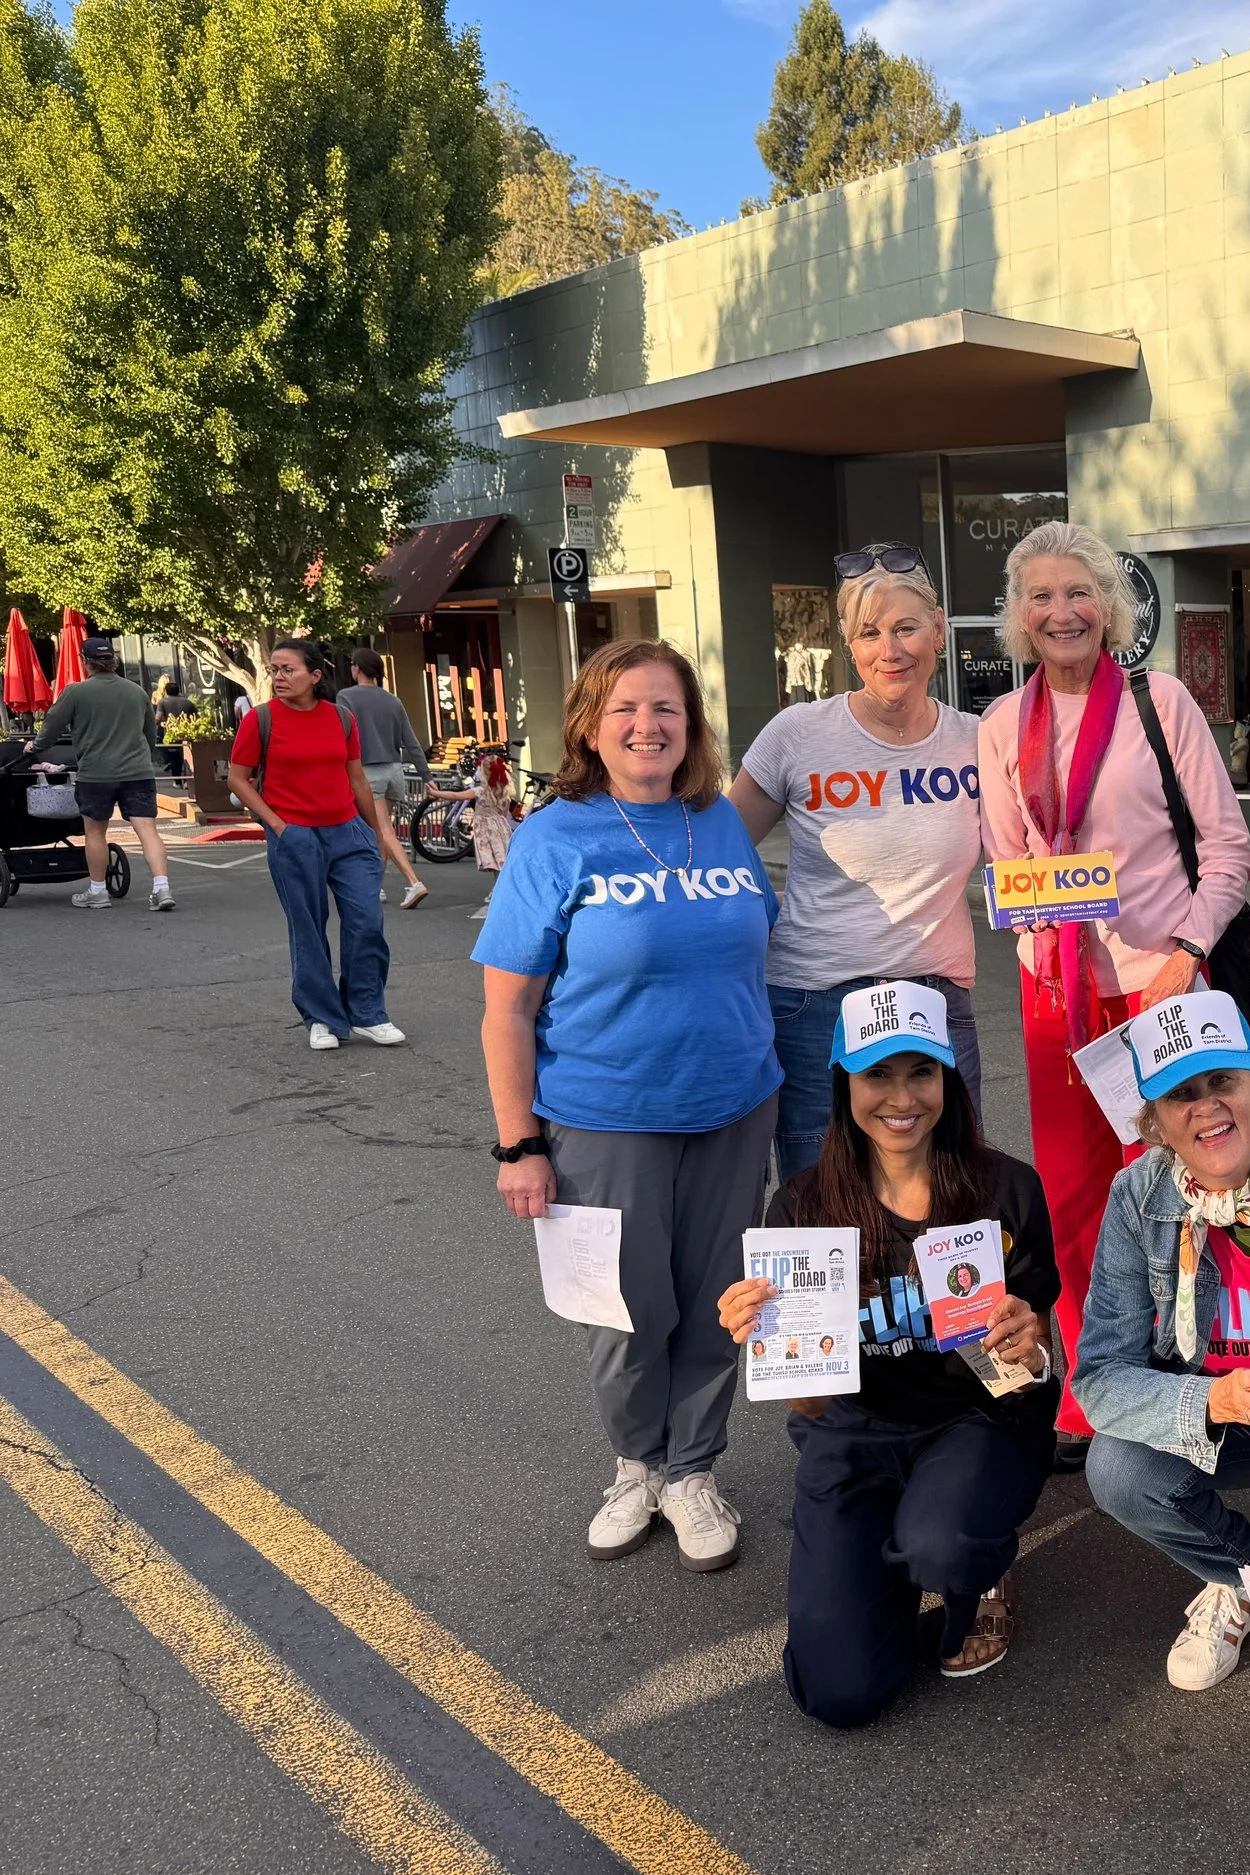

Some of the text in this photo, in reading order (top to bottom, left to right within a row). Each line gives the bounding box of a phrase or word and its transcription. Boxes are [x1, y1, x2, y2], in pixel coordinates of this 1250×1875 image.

[569, 507, 592, 517] 2 HOUR
[570, 520, 593, 529] PARKING
[561, 556, 577, 575] P
[964, 661, 1011, 672] CURATE
[805, 764, 980, 811] JOY KOO
[583, 867, 764, 905] JOY KOO
[1000, 866, 1111, 895] JOY KOO
[871, 990, 896, 1007] FLIP
[874, 1004, 898, 1020] THE
[1157, 1004, 1182, 1028] FLIP
[860, 1017, 899, 1041] BOARD
[1162, 1020, 1189, 1040] THE
[1153, 1035, 1193, 1064] BOARD
[928, 1239, 951, 1256] JOY
[954, 1230, 984, 1248] KOO
[792, 1256, 810, 1271] THE
[793, 1271, 826, 1288] BOARD
[862, 1343, 892, 1357] VOTE
[892, 1337, 914, 1357] OUT
[1207, 1341, 1229, 1358] OTE
[826, 1361, 849, 1371] NOV 3
